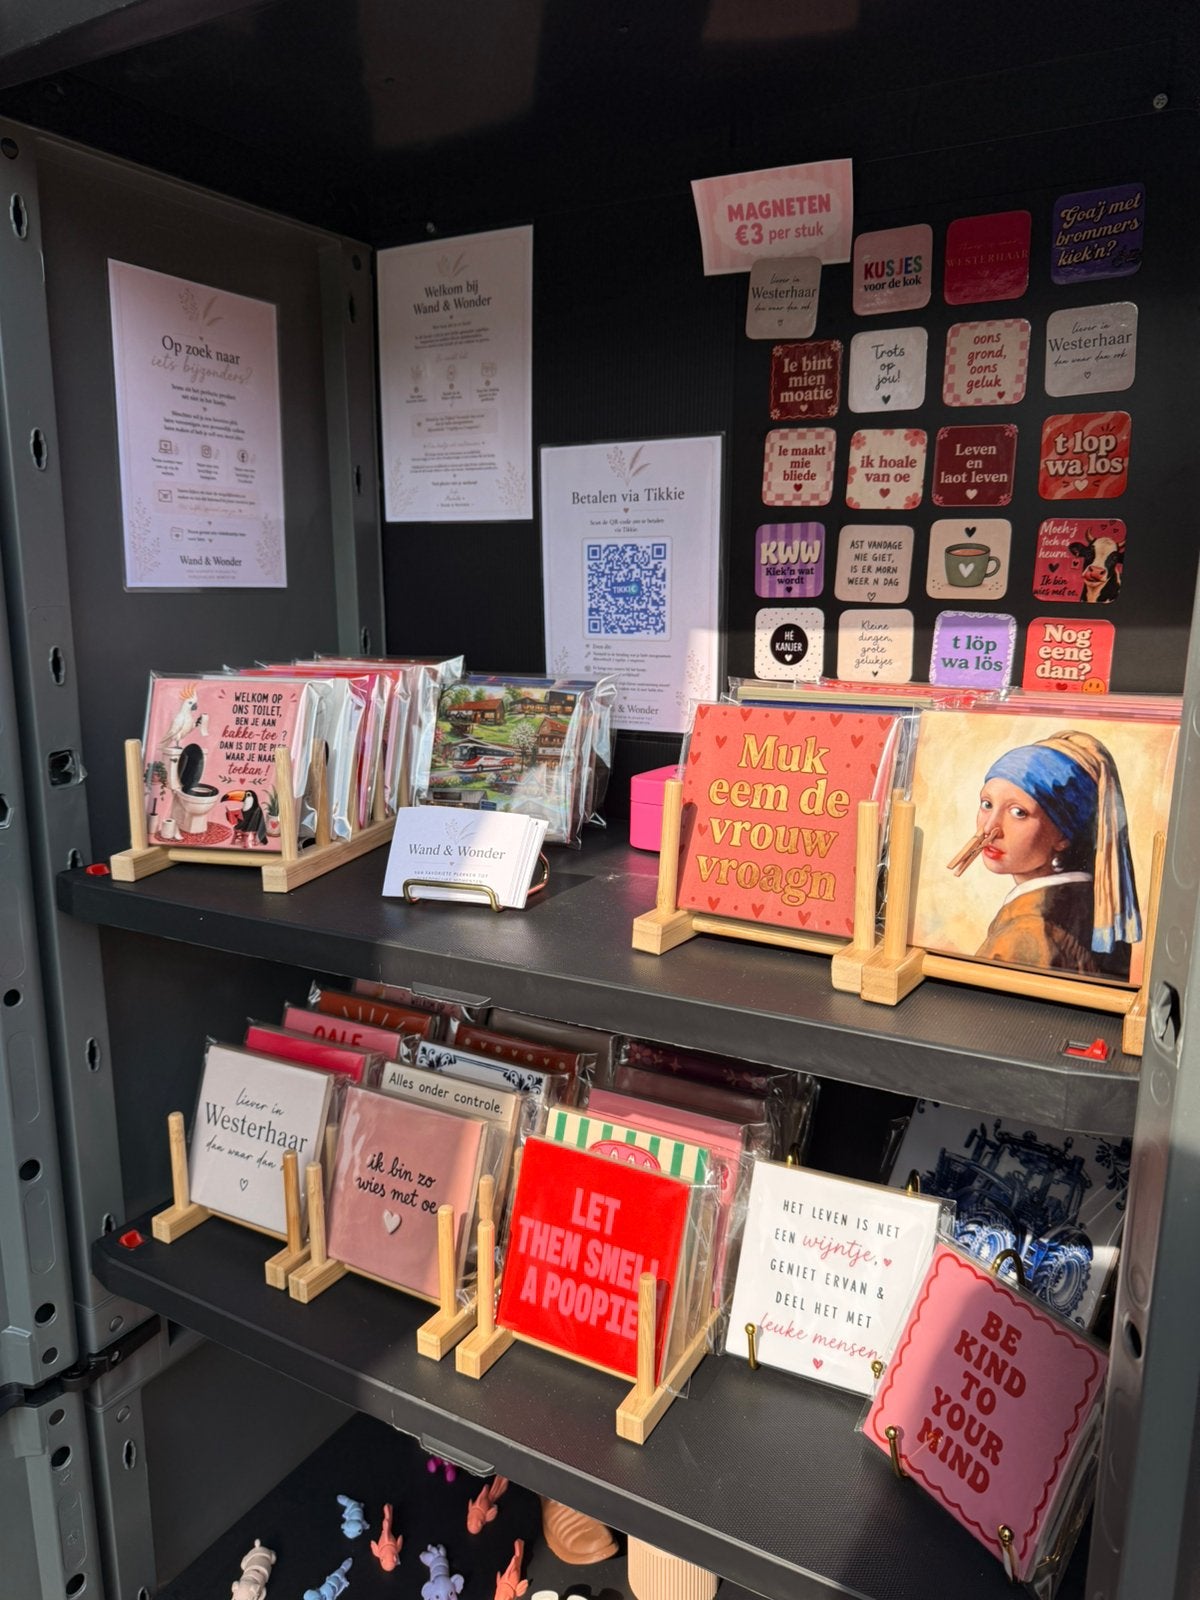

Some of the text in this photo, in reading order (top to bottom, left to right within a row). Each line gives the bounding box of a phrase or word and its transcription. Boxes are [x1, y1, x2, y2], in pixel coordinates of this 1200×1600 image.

[728, 193, 831, 222] MAGNETEN
[1110, 192, 1142, 213] met
[735, 221, 823, 246] €3 per stuk
[1055, 217, 1141, 247] brommers
[863, 255, 922, 280] KUSJES
[424, 280, 479, 298] Welkom bij
[863, 274, 922, 292] voor de kok
[751, 286, 816, 300] Westerhaar
[413, 295, 492, 315] Wand & Wonder
[973, 332, 1001, 345] oons
[1048, 332, 1133, 351] Westerhaar
[162, 335, 240, 365] Op zoek naar
[872, 344, 905, 360] Trots
[967, 345, 1007, 366] grond,
[151, 354, 176, 370] iets
[802, 356, 833, 371] bint
[880, 362, 895, 375] op
[970, 364, 998, 375] oons
[789, 372, 826, 387] mien
[875, 370, 901, 391] jou!
[966, 375, 1002, 394] geluk
[780, 386, 834, 403] moatie
[791, 445, 827, 456] maakt
[955, 444, 997, 456] Leven
[1054, 431, 1117, 456] t lop
[790, 458, 811, 469] mie
[860, 455, 917, 469] ik hoale
[966, 459, 983, 469] en
[1046, 453, 1124, 476] wa los
[783, 469, 817, 481] bliede
[865, 472, 911, 482] van oe
[940, 472, 1008, 484] laot leven
[572, 486, 685, 505] Betalen via Tikkie
[760, 540, 822, 565] KWW
[850, 540, 903, 550] AST VANDAGE
[180, 555, 242, 567] Wand & Wonder
[854, 553, 895, 563] NIE GIET,
[765, 567, 814, 576] Kiek'n wat
[850, 565, 898, 574] IS ER MORN
[777, 576, 805, 585] wordt
[848, 577, 869, 585] WEER
[883, 578, 899, 586] DAG
[1040, 574, 1068, 586] Ik bin
[1052, 586, 1067, 596] met
[861, 620, 889, 631] Kleine
[784, 630, 794, 641] HÉ
[952, 635, 998, 652] t löp
[1043, 623, 1093, 648] Nog
[775, 642, 803, 652] KANJER
[861, 645, 887, 657] grote
[1038, 646, 1093, 663] eene
[855, 656, 893, 669] gelukjes
[941, 656, 1003, 671] wa lös
[1035, 661, 1092, 681] dan?
[234, 692, 283, 704] WELKOM OP
[232, 704, 282, 718] ONS TOILET,
[627, 705, 659, 714] Wonder
[235, 717, 276, 726] BEN JE AAN
[221, 725, 278, 739] kakke-toe
[220, 741, 266, 751] DAN IS DIT DE
[737, 733, 830, 775] Muk
[225, 752, 255, 762] WAAR JE
[228, 762, 263, 775] toekan
[708, 778, 850, 819] eem de
[709, 817, 839, 859] vrouw
[408, 844, 506, 860] Wand & Wonder
[696, 854, 837, 908] vroagn
[388, 1072, 503, 1114] Alles onder controle.
[235, 1088, 285, 1116] liever in
[205, 1102, 308, 1153] Westerhaar
[206, 1134, 225, 1152] dan
[227, 1146, 253, 1161] waar
[256, 1150, 276, 1169] dan
[366, 1152, 436, 1189] ik bin zo
[355, 1176, 438, 1215] wies met oe
[571, 1187, 621, 1236] LET
[783, 1199, 901, 1239] HET LEVEN IS NET
[518, 1215, 582, 1272] THEM
[774, 1228, 797, 1244] EEN
[770, 1258, 885, 1300] GENIET ERVAN &
[519, 1265, 640, 1342] A POOPIE
[775, 1291, 872, 1329] DEEL HET MET
[759, 1312, 808, 1340] leuke
[980, 1310, 1022, 1357] BE
[953, 1329, 1027, 1398] KIND
[960, 1370, 997, 1416] TO
[931, 1385, 1004, 1466] YOUR
[916, 1417, 990, 1494] MIND
